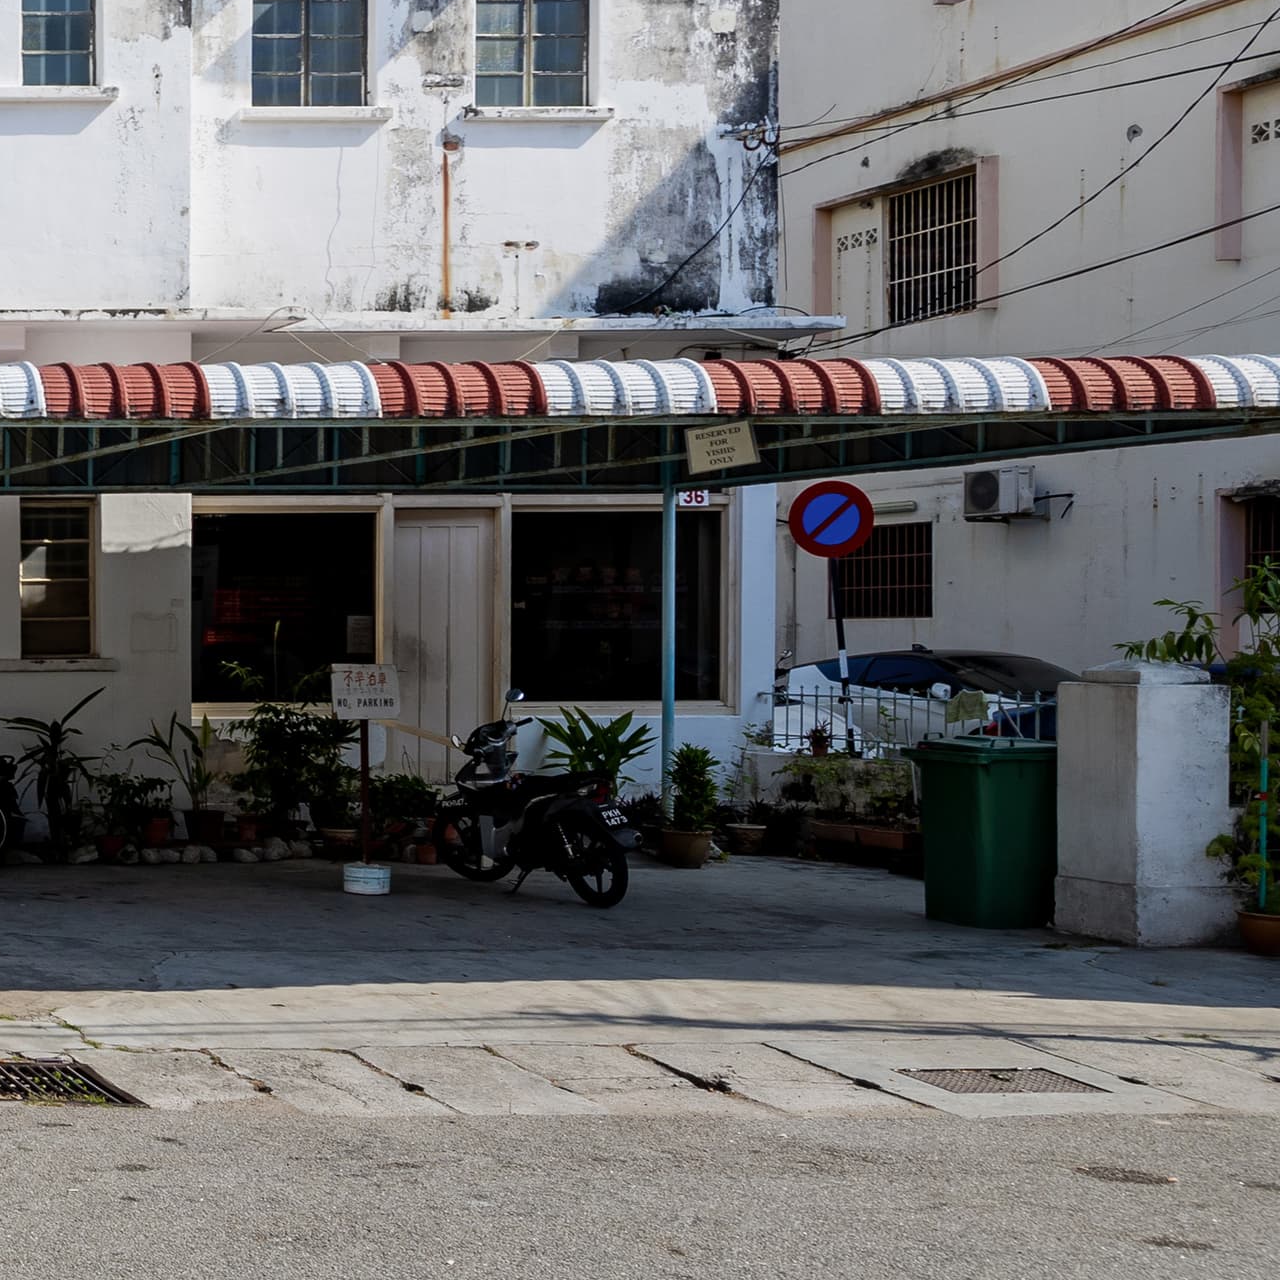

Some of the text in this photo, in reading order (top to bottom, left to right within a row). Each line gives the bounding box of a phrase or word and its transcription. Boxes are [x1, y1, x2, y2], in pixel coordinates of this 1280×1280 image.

[695, 426, 741, 441] RESERVED
[710, 438, 729, 447] FOR
[709, 455, 735, 466] ONLY
[683, 490, 705, 505] 36
[357, 698, 394, 708] PARKING
[602, 809, 621, 819] PKH
[606, 815, 628, 826] 1473
